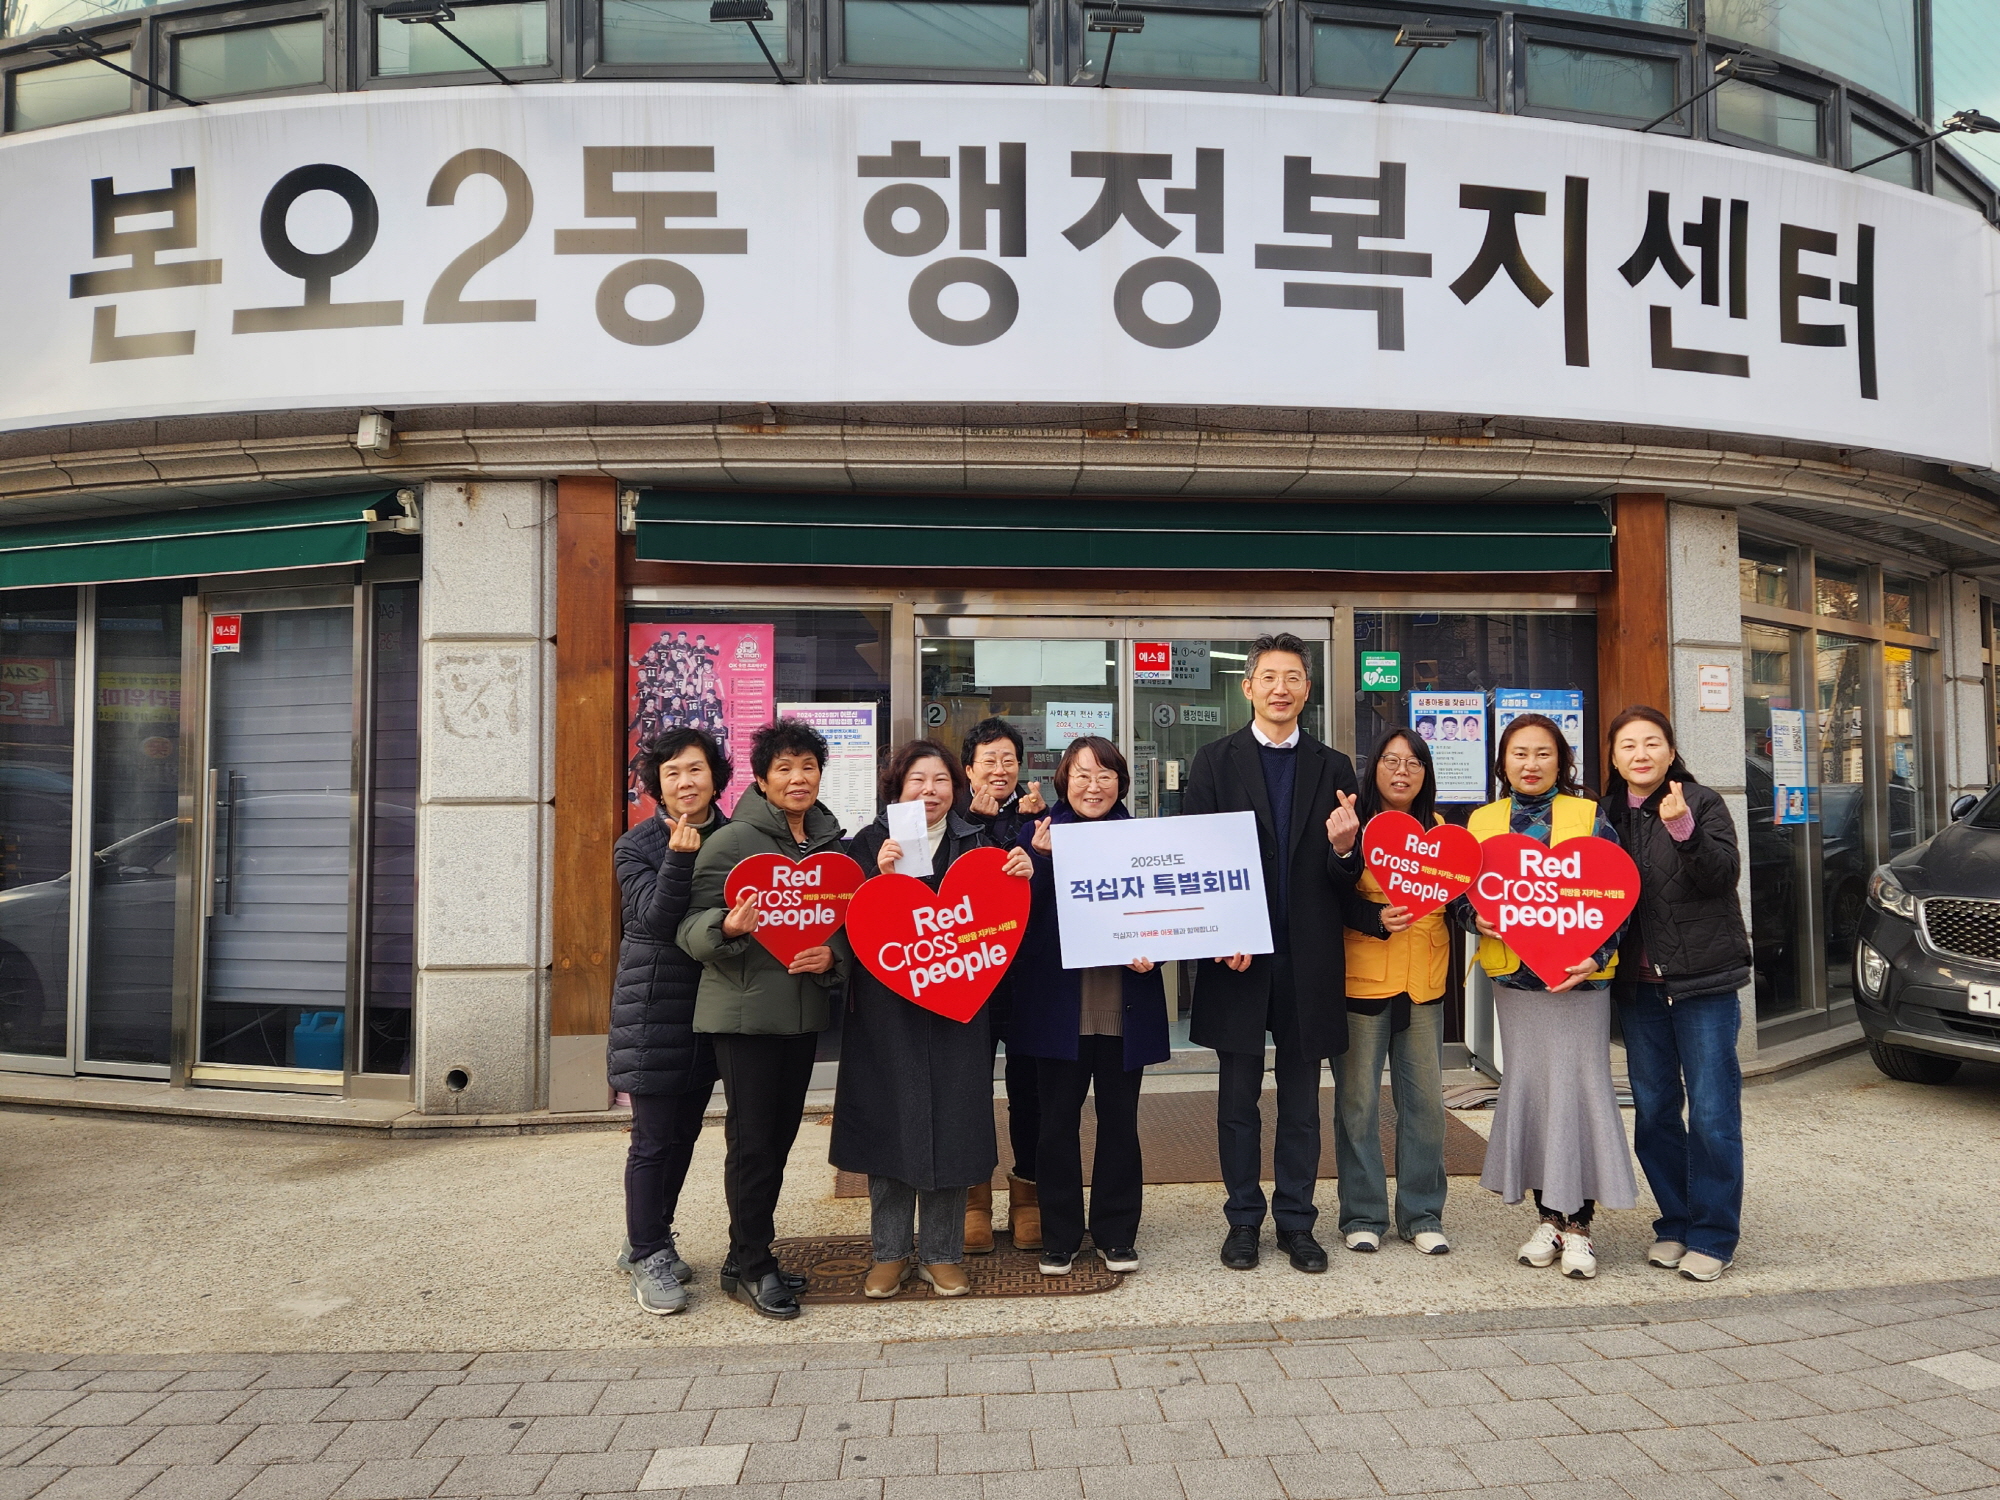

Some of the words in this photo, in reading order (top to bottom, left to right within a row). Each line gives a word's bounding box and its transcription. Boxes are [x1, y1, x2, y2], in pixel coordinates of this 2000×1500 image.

[69, 146, 748, 363] 본오2동
[857, 140, 1878, 401] 행정복지센터
[215, 625, 237, 636] 에스원
[1138, 651, 1166, 663] 에스원
[1378, 675, 1398, 684] AED
[929, 707, 941, 723] 2
[1049, 710, 1076, 718] 사회복지
[1096, 710, 1111, 718] 중단
[1159, 707, 1171, 724] 3
[1183, 710, 1217, 722] 행정민원팀
[1404, 833, 1441, 859] Red
[1130, 853, 1186, 868] 2025년도
[1370, 847, 1420, 875] Cross
[1421, 865, 1438, 875] 희망을
[1438, 869, 1454, 880] 지키는
[1454, 873, 1471, 884] 사람들
[1520, 848, 1581, 879] Red
[772, 865, 821, 888] Red
[1070, 876, 1145, 902] 적십자
[1152, 868, 1251, 897] 특별회비
[1388, 872, 1449, 902] People
[1477, 872, 1558, 902] Cross
[1560, 888, 1581, 897] 희망을
[1581, 889, 1603, 898] 지키는
[1603, 890, 1625, 899] 사람들
[736, 886, 802, 908] Cross
[756, 904, 836, 932] people
[912, 895, 974, 936] Red
[1499, 900, 1604, 935] people
[1112, 930, 1139, 940] 적십자가
[1140, 929, 1159, 938] 어려운
[1160, 927, 1186, 937] 이웃들과
[1187, 925, 1219, 935] 함께합니다
[878, 932, 958, 972] Cross
[957, 931, 978, 944] 희망을
[978, 926, 998, 940] 지키는
[997, 920, 1018, 936] 사람들
[908, 940, 1008, 997] people
